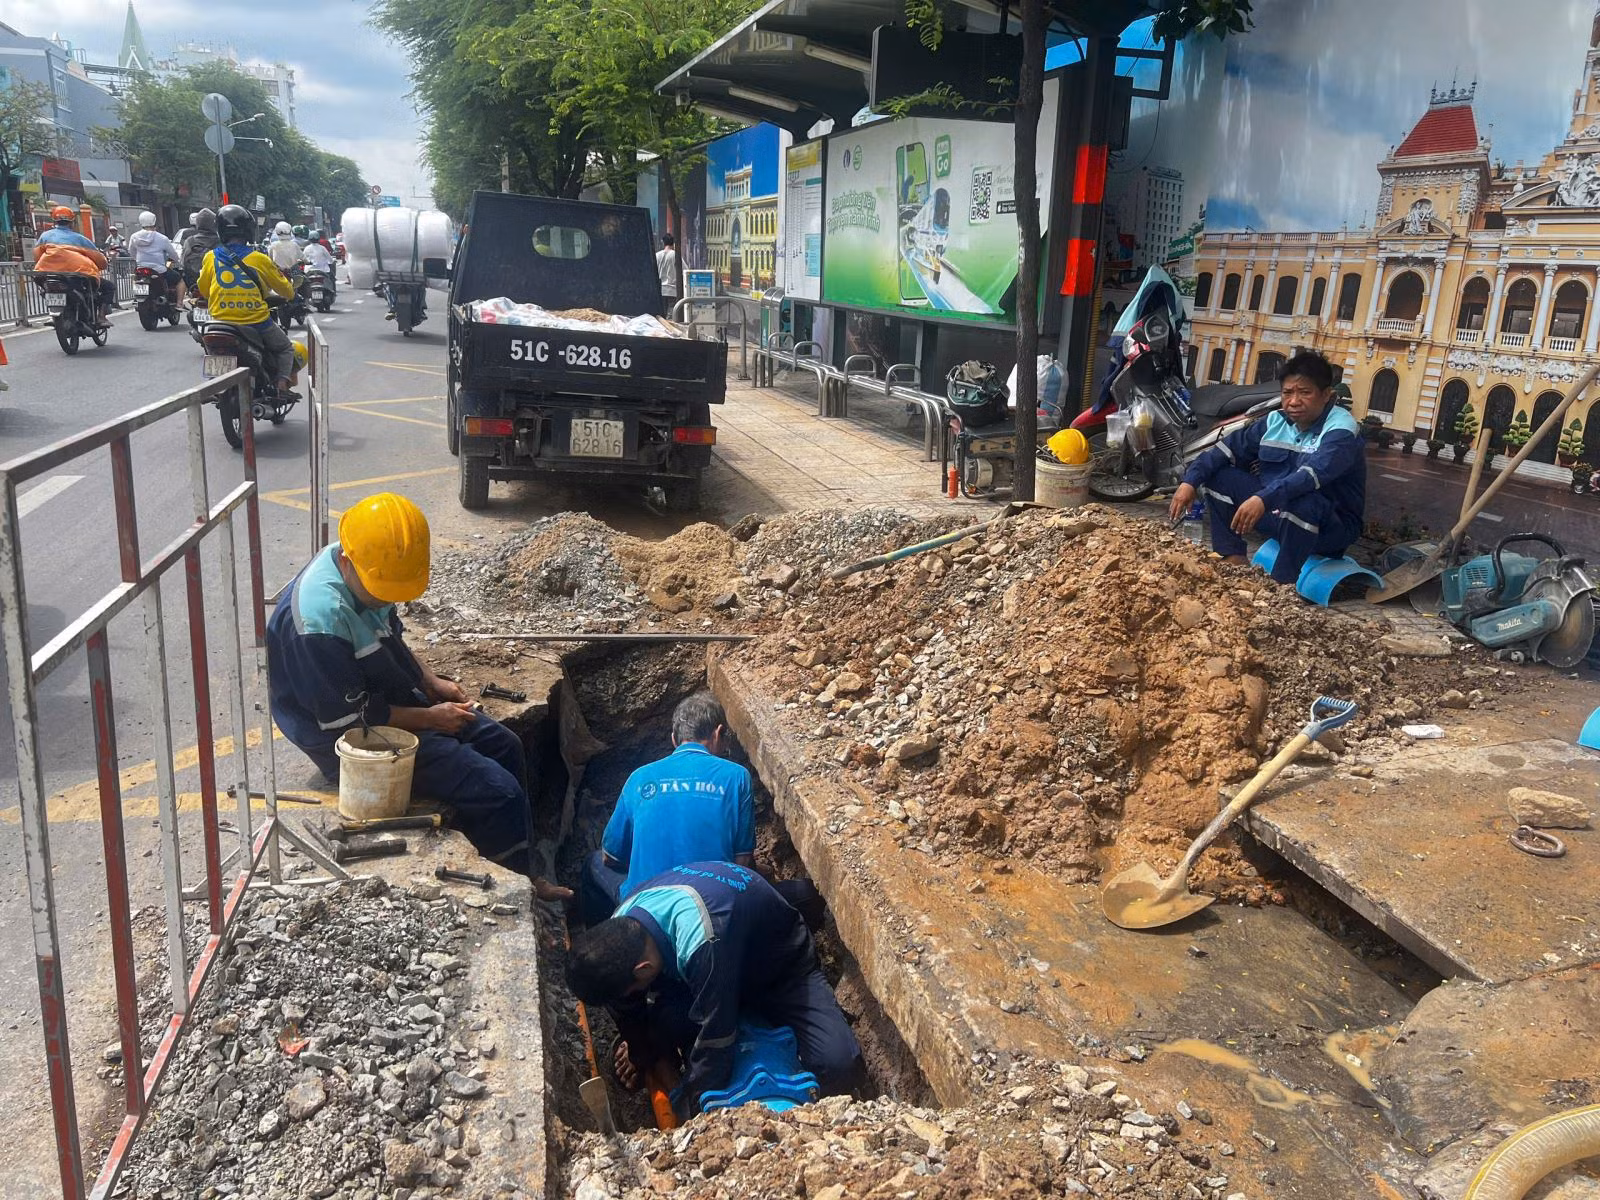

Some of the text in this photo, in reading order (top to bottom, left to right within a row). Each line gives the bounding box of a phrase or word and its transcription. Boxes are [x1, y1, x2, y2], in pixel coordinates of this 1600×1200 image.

[936, 156, 949, 172] Go
[510, 339, 632, 369] 51C -628.16
[583, 421, 612, 438] 51C
[660, 780, 726, 796] TÂN HÒA
